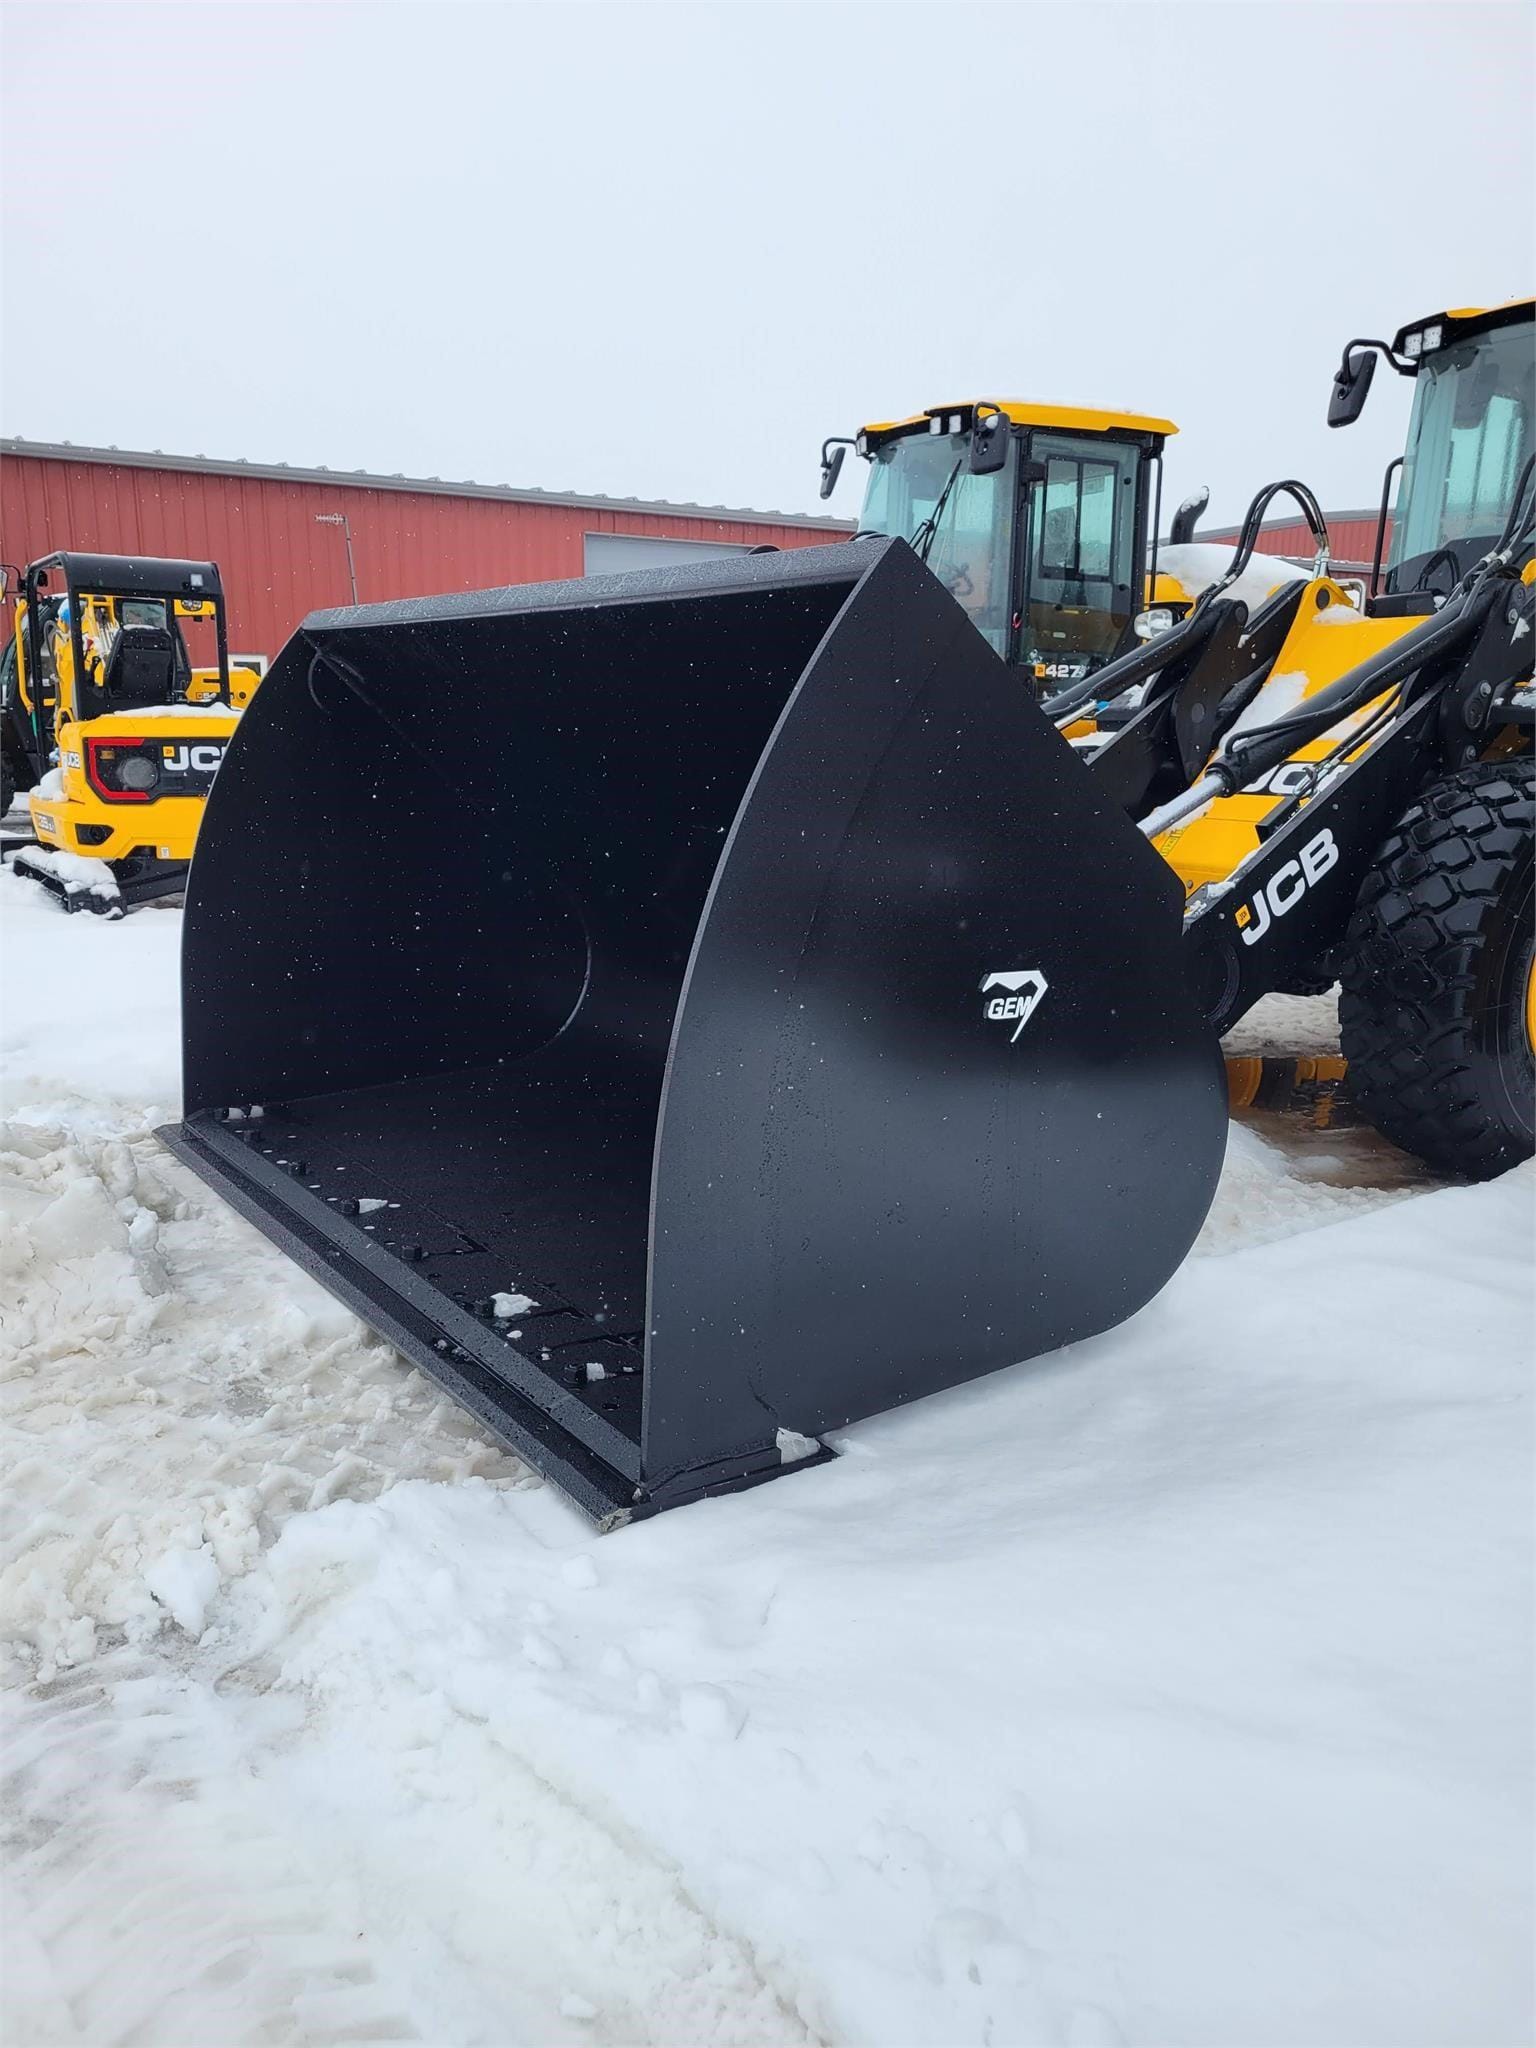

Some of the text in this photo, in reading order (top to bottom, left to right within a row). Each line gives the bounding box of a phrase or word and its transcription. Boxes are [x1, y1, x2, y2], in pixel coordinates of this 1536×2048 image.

[1045, 664, 1083, 678] 427
[163, 745, 228, 771] JC
[1241, 827, 1339, 946] JCB
[987, 995, 1033, 1020] GEM
